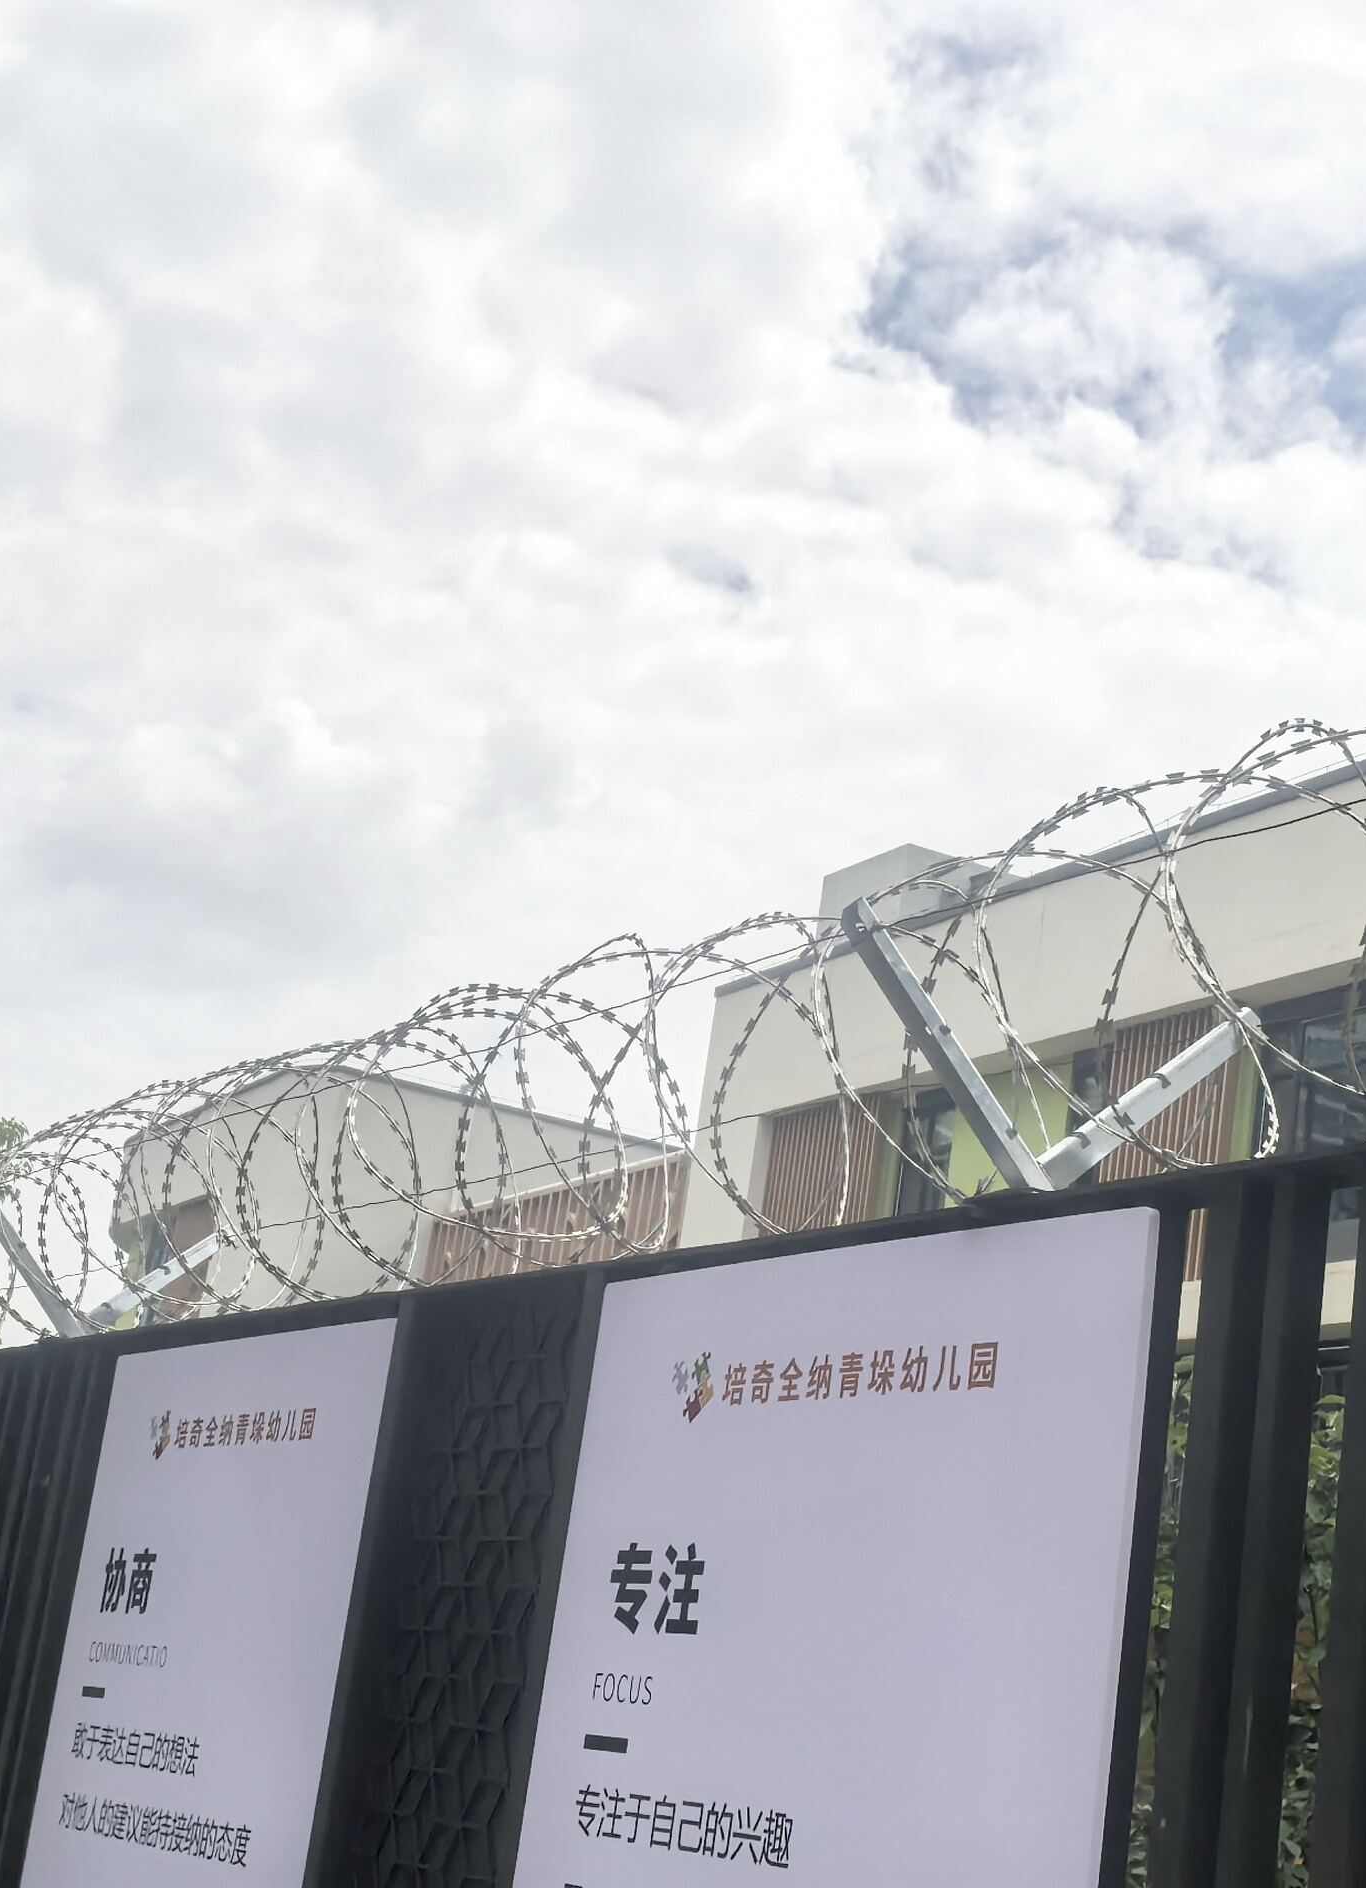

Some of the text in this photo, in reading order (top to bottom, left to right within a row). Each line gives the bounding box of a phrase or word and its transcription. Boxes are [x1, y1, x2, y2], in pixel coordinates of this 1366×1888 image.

[722, 1341, 999, 1406] 培奇全纳青垛幼儿园
[174, 1408, 316, 1449] 培奇全纳青垛幼儿园
[99, 1547, 157, 1615] 协商
[610, 1542, 705, 1635] 专注
[592, 1672, 653, 1705] FOCUS
[71, 1722, 200, 1777] 敢于表达自己的想法
[59, 1792, 252, 1868] 对他人的建议能持接纳的态度
[576, 1784, 793, 1869] 专注于自己的兴趣
